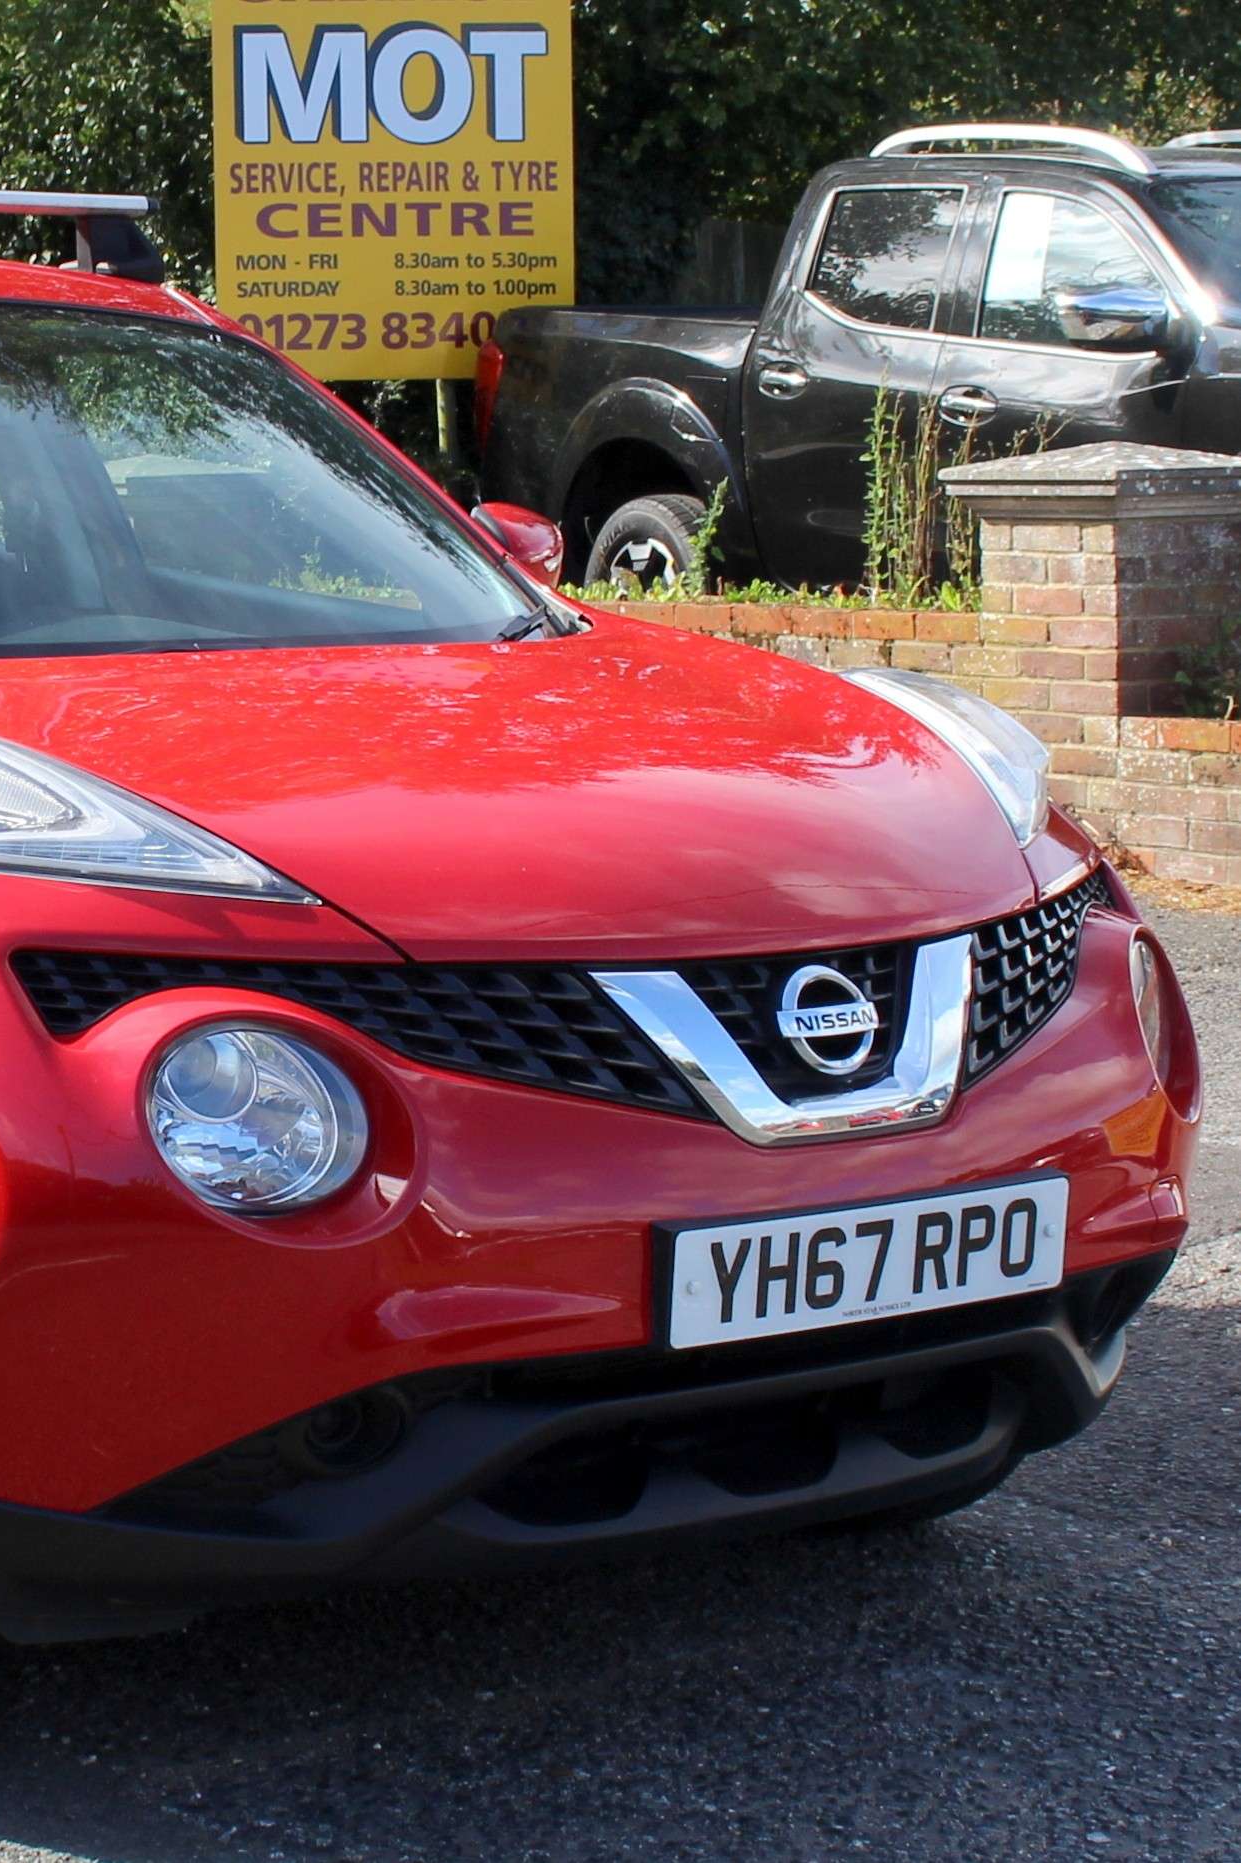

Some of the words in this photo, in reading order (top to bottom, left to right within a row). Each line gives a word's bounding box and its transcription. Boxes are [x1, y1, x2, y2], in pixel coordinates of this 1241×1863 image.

[234, 21, 549, 145] MOT
[230, 161, 345, 197] SERVICE,
[359, 161, 450, 192] REPAIR
[462, 161, 479, 192] &
[491, 160, 558, 192] TYRE
[255, 202, 535, 239] CENTRE
[236, 254, 286, 271] MON
[309, 253, 339, 270] FRI
[394, 252, 459, 270] 8.30am
[466, 253, 485, 269] to
[492, 252, 557, 272] 5.30pm
[237, 280, 340, 298] SATURDAY
[395, 280, 459, 297] 8.30am
[466, 280, 486, 296] to
[493, 279, 556, 299] 1.00pm
[795, 1009, 873, 1032] NISSAN
[711, 1219, 894, 1324] YH67
